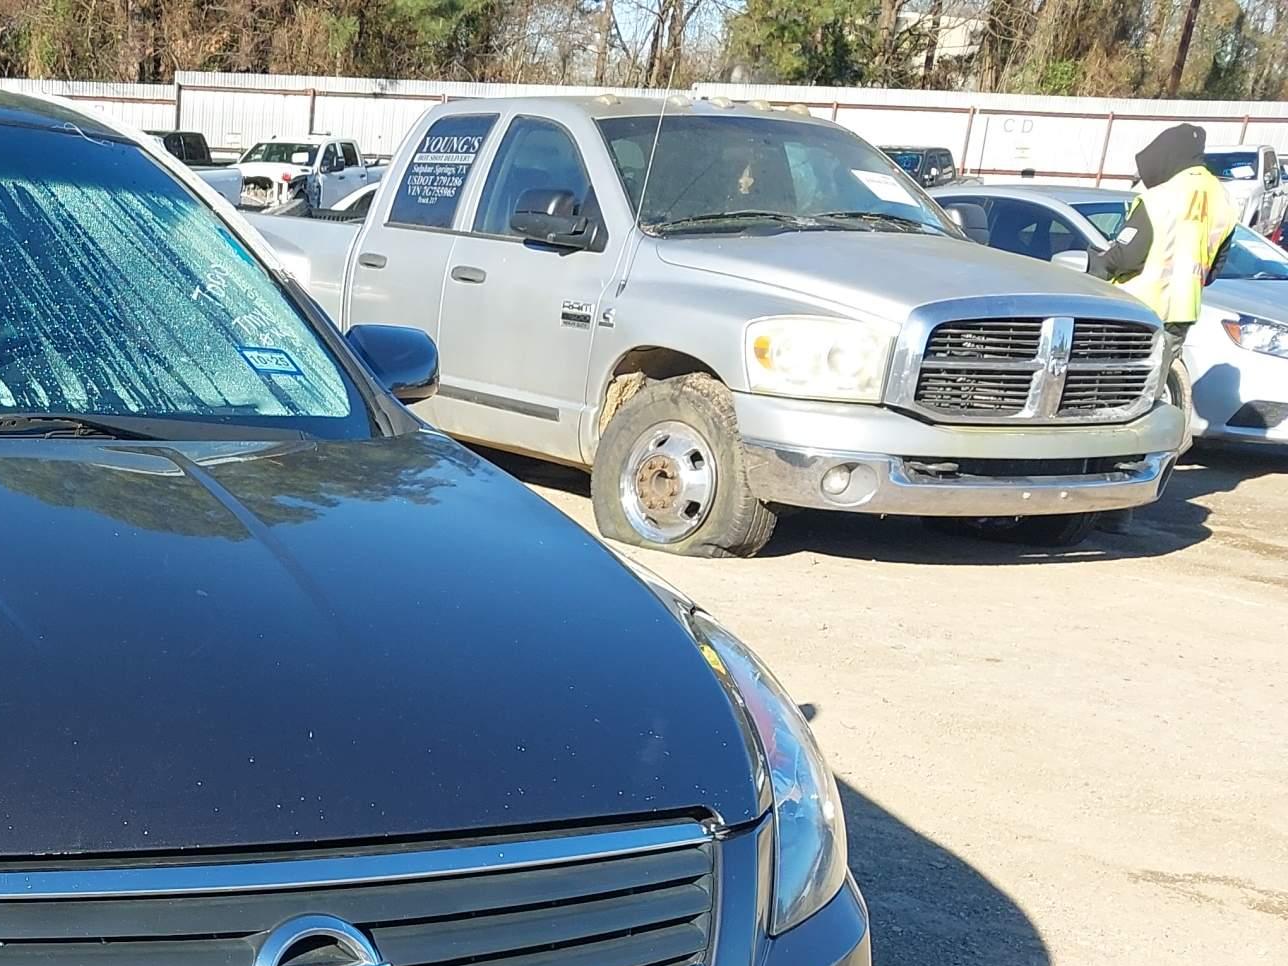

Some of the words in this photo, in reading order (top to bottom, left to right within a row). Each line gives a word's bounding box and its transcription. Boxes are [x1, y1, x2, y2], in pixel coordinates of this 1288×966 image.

[422, 136, 483, 153] YOUNG'S
[456, 165, 467, 175] TX
[407, 175, 434, 186] USDOT
[408, 186, 423, 196] VIN
